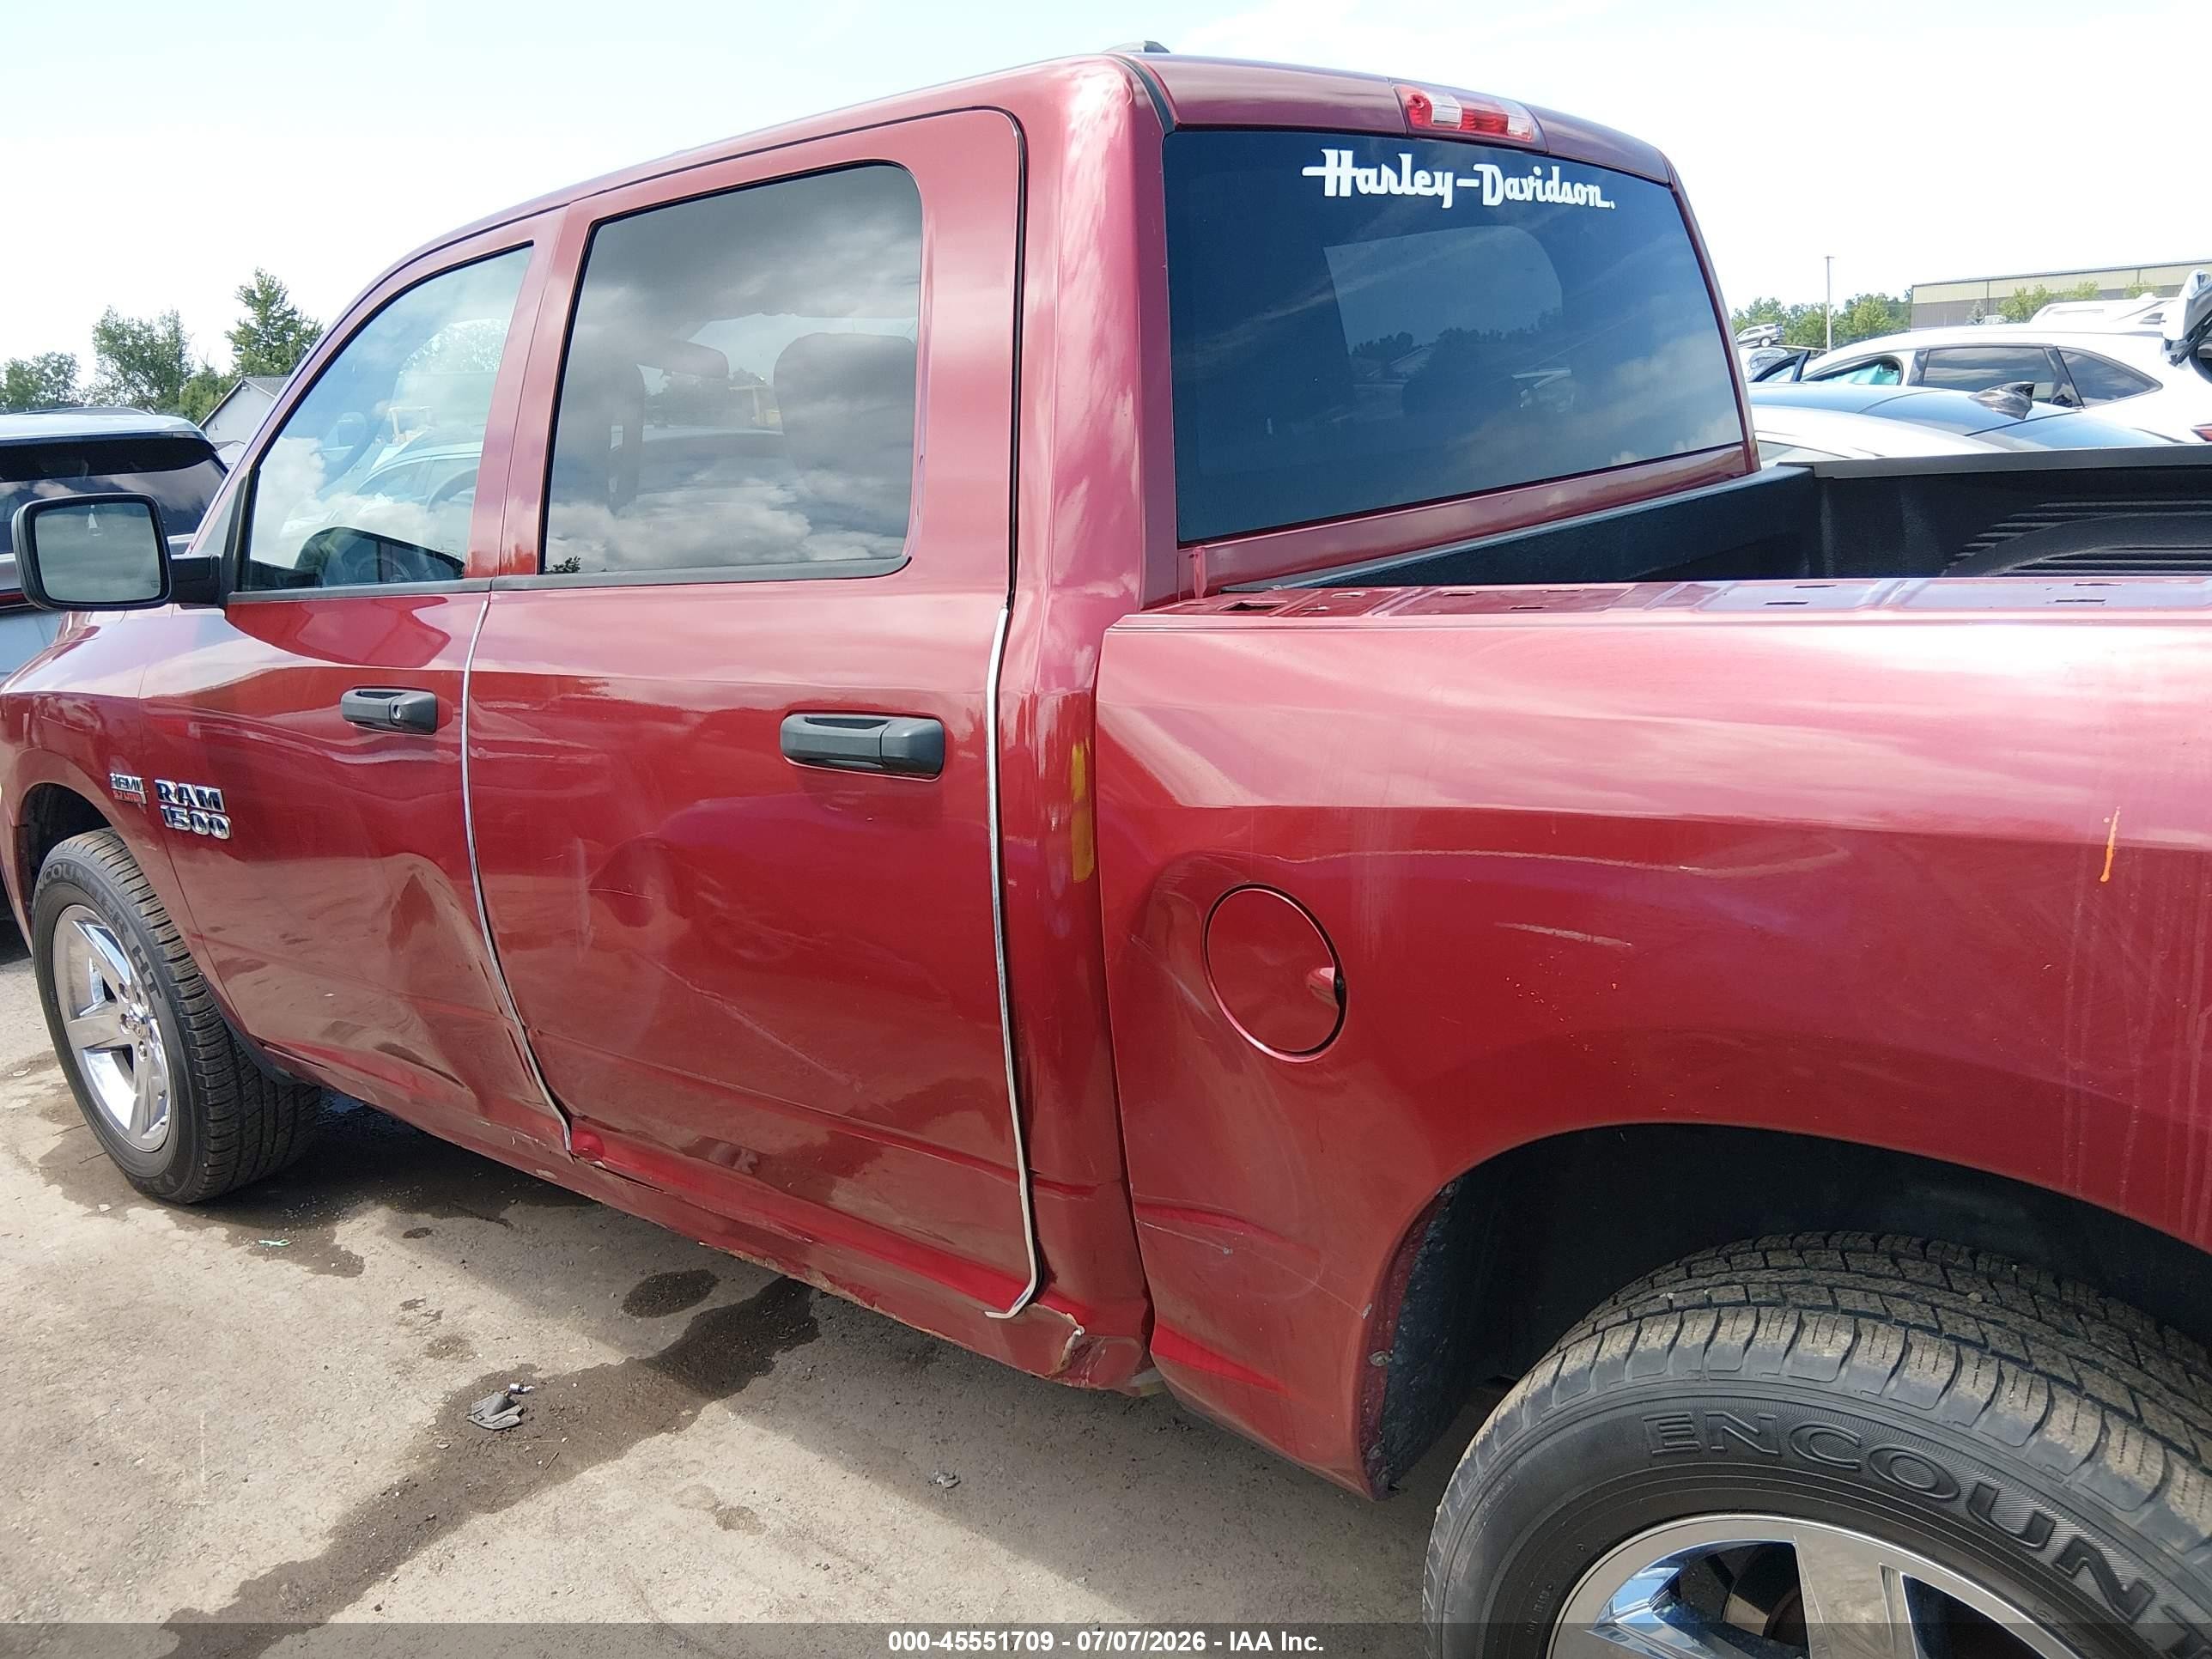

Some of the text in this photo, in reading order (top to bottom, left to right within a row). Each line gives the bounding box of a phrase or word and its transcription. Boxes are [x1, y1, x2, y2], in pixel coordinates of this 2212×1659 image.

[155, 779, 227, 813] RAM
[160, 805, 232, 841] 1500
[34, 861, 162, 1000] NCOUNTER HT
